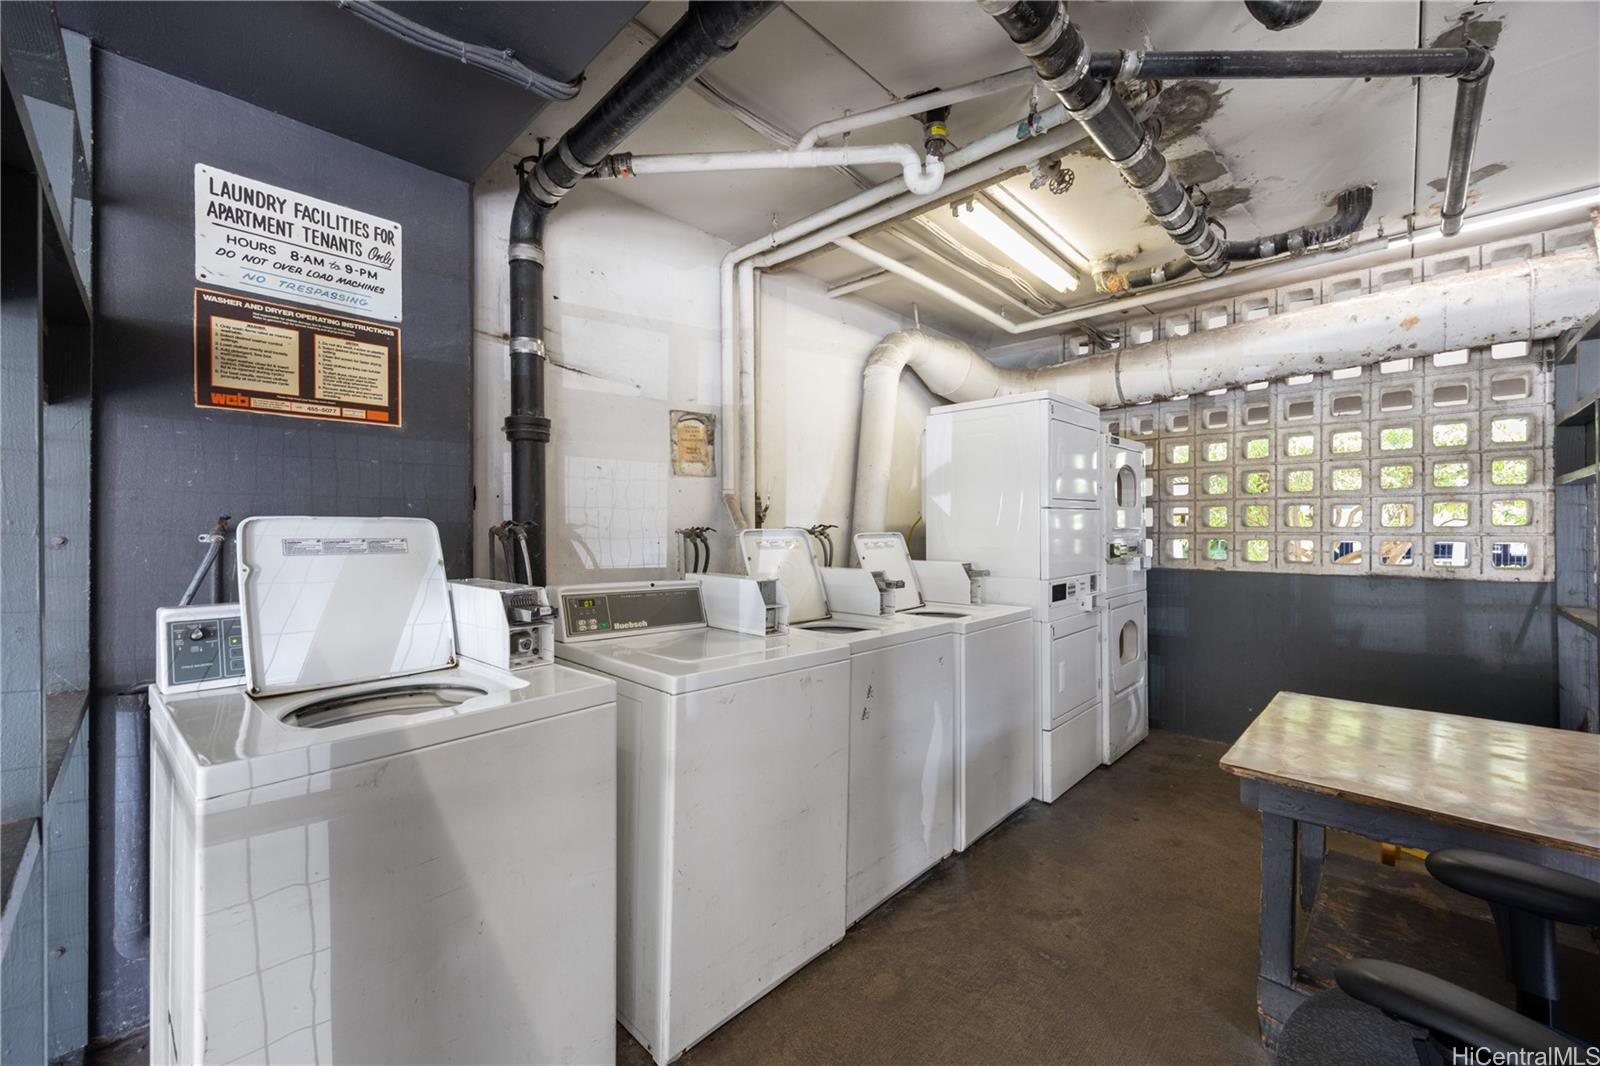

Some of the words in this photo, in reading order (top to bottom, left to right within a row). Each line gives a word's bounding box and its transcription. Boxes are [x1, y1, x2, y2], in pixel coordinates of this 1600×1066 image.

[209, 177, 286, 214] LAUNDRY
[294, 202, 369, 239] FACILITIES
[374, 226, 395, 246] FOR
[206, 202, 294, 238] APARTMENT
[302, 226, 362, 257] TENANTS
[368, 247, 394, 268] Only
[226, 234, 276, 255] HOURS
[290, 250, 325, 267] 8-AM
[329, 261, 342, 270] to
[344, 264, 378, 280] 9-PM
[215, 248, 236, 258] DO
[242, 254, 268, 266] NOT
[273, 262, 302, 276] OVER
[306, 270, 334, 282] LOAD
[336, 278, 386, 294] MACHINES
[242, 272, 266, 284] NO
[279, 280, 369, 306] TRESPASSING
[203, 294, 242, 308] WASHER
[244, 302, 264, 311] AND
[265, 306, 294, 318] DRYER
[296, 312, 340, 327] OPERATING
[342, 322, 394, 336] INSTRUCTIONS
